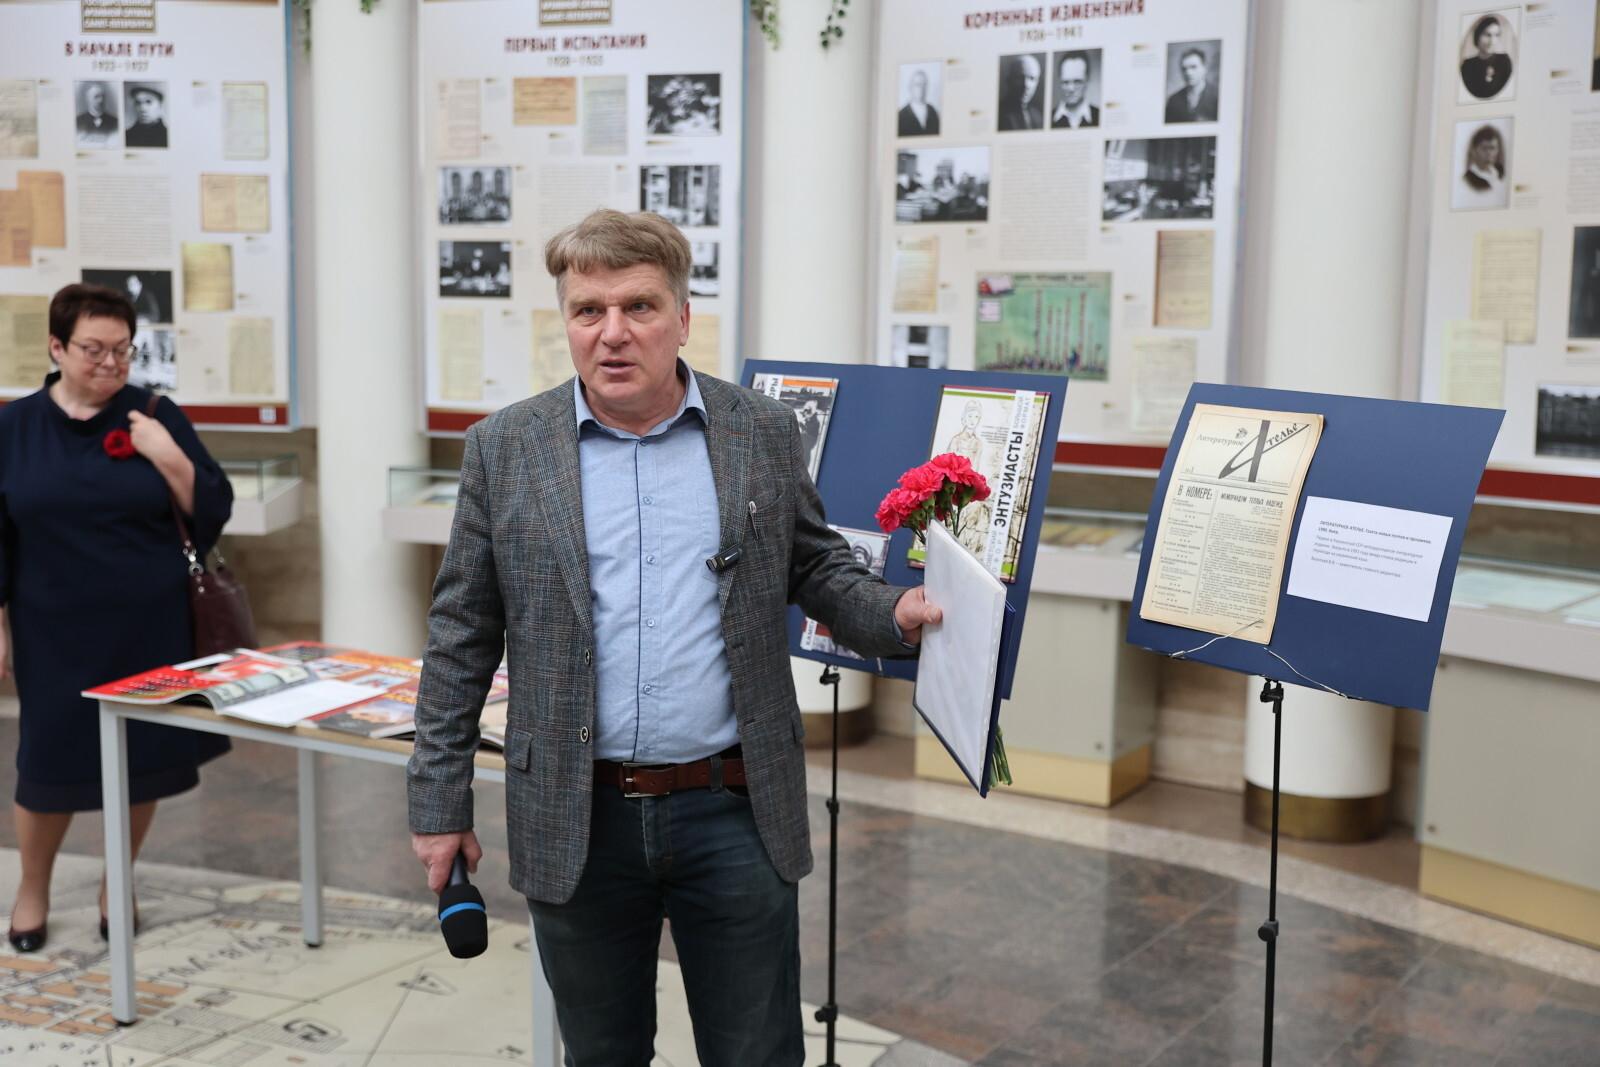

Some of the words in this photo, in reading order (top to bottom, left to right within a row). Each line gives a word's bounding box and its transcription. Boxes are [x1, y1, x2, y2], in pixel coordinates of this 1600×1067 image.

[963, 7, 1044, 29] КОРЕННЫЕ
[1050, 0, 1145, 21] ИЗМЕНЕНИЯ
[65, 42, 73, 56] В
[79, 42, 131, 56] НАЧАЛЕ
[138, 42, 175, 57] ПУТИ
[504, 37, 557, 52] ПЕРВЫЕ
[562, 33, 648, 49] ИСПЫТАНИЯ
[1197, 434, 1245, 447] Литературное
[994, 431, 1024, 528] ЭНТУЗИАСТЫ
[1177, 484, 1184, 497] В
[1186, 486, 1213, 501] НОМЕРЕ:
